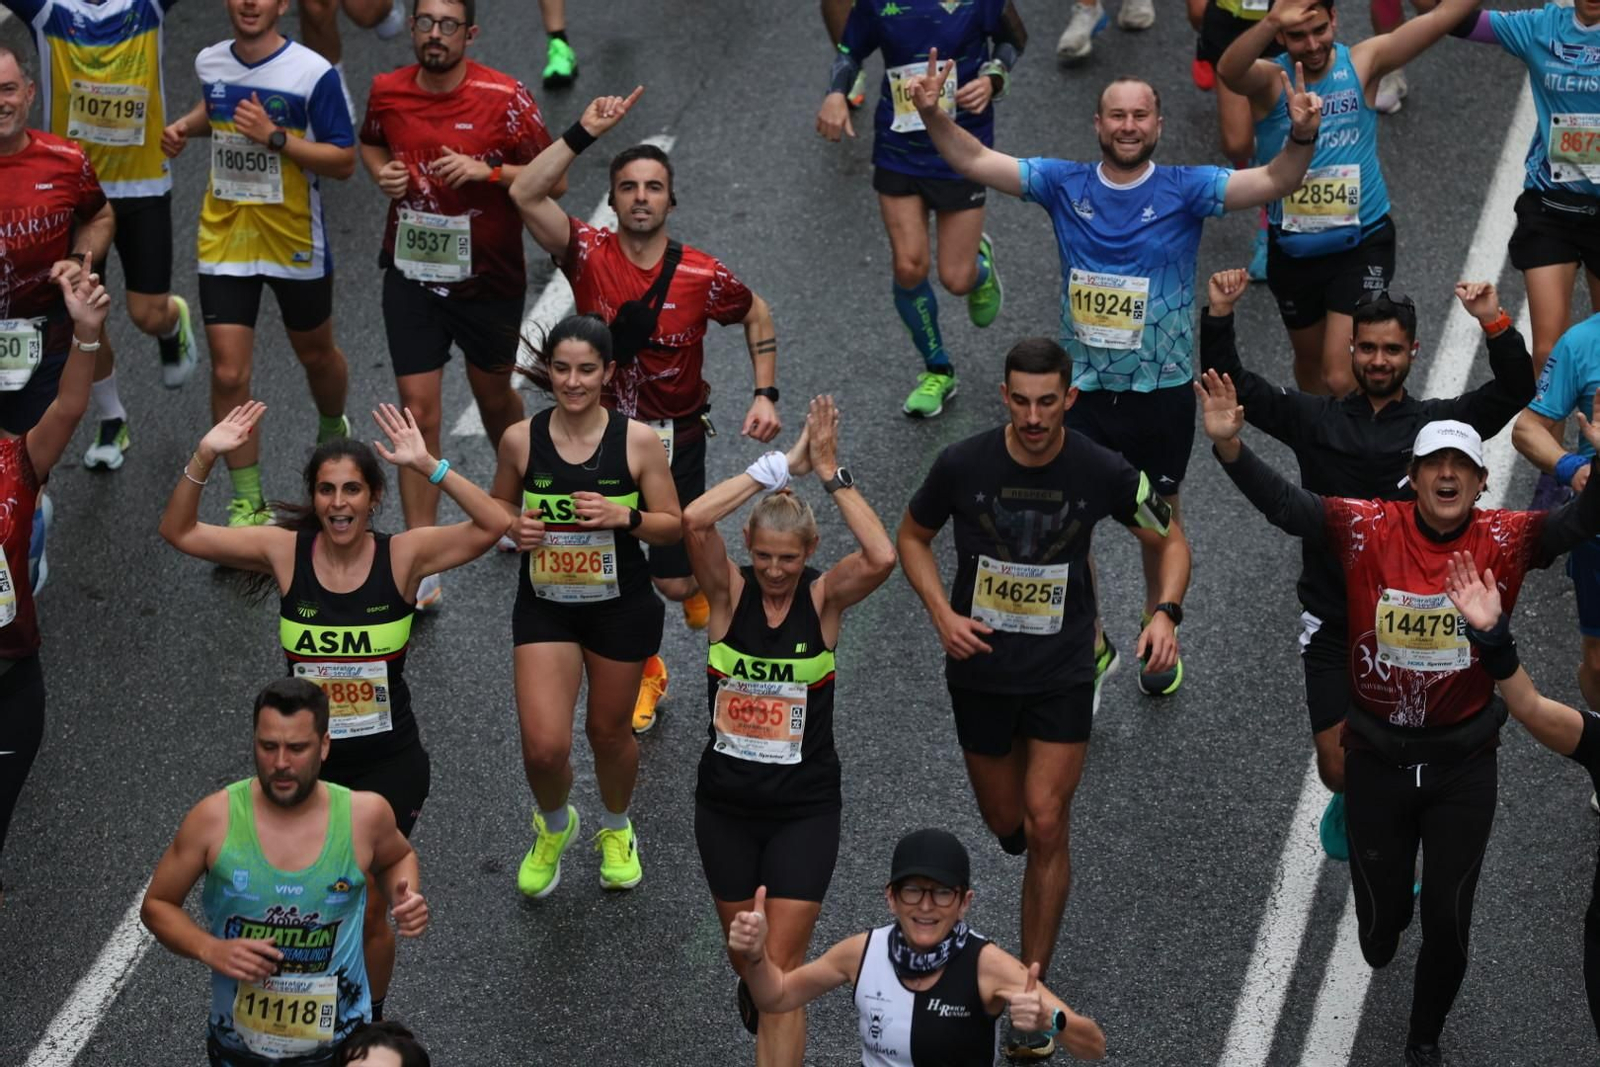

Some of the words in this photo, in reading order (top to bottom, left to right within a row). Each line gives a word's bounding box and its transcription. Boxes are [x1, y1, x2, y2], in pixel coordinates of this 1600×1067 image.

[1544, 73, 1600, 92] ATLETIS
[78, 95, 135, 118] 10719
[216, 149, 268, 172] 18050
[407, 228, 451, 254] 9537
[1075, 289, 1132, 317] 11924
[538, 498, 591, 521] AS
[537, 550, 602, 573] 13926
[984, 576, 1052, 604] 14625
[1384, 610, 1456, 637] 14479
[294, 630, 373, 654] ASM
[732, 658, 795, 682] ASM
[321, 681, 375, 704] 889
[246, 993, 317, 1025] 11118
